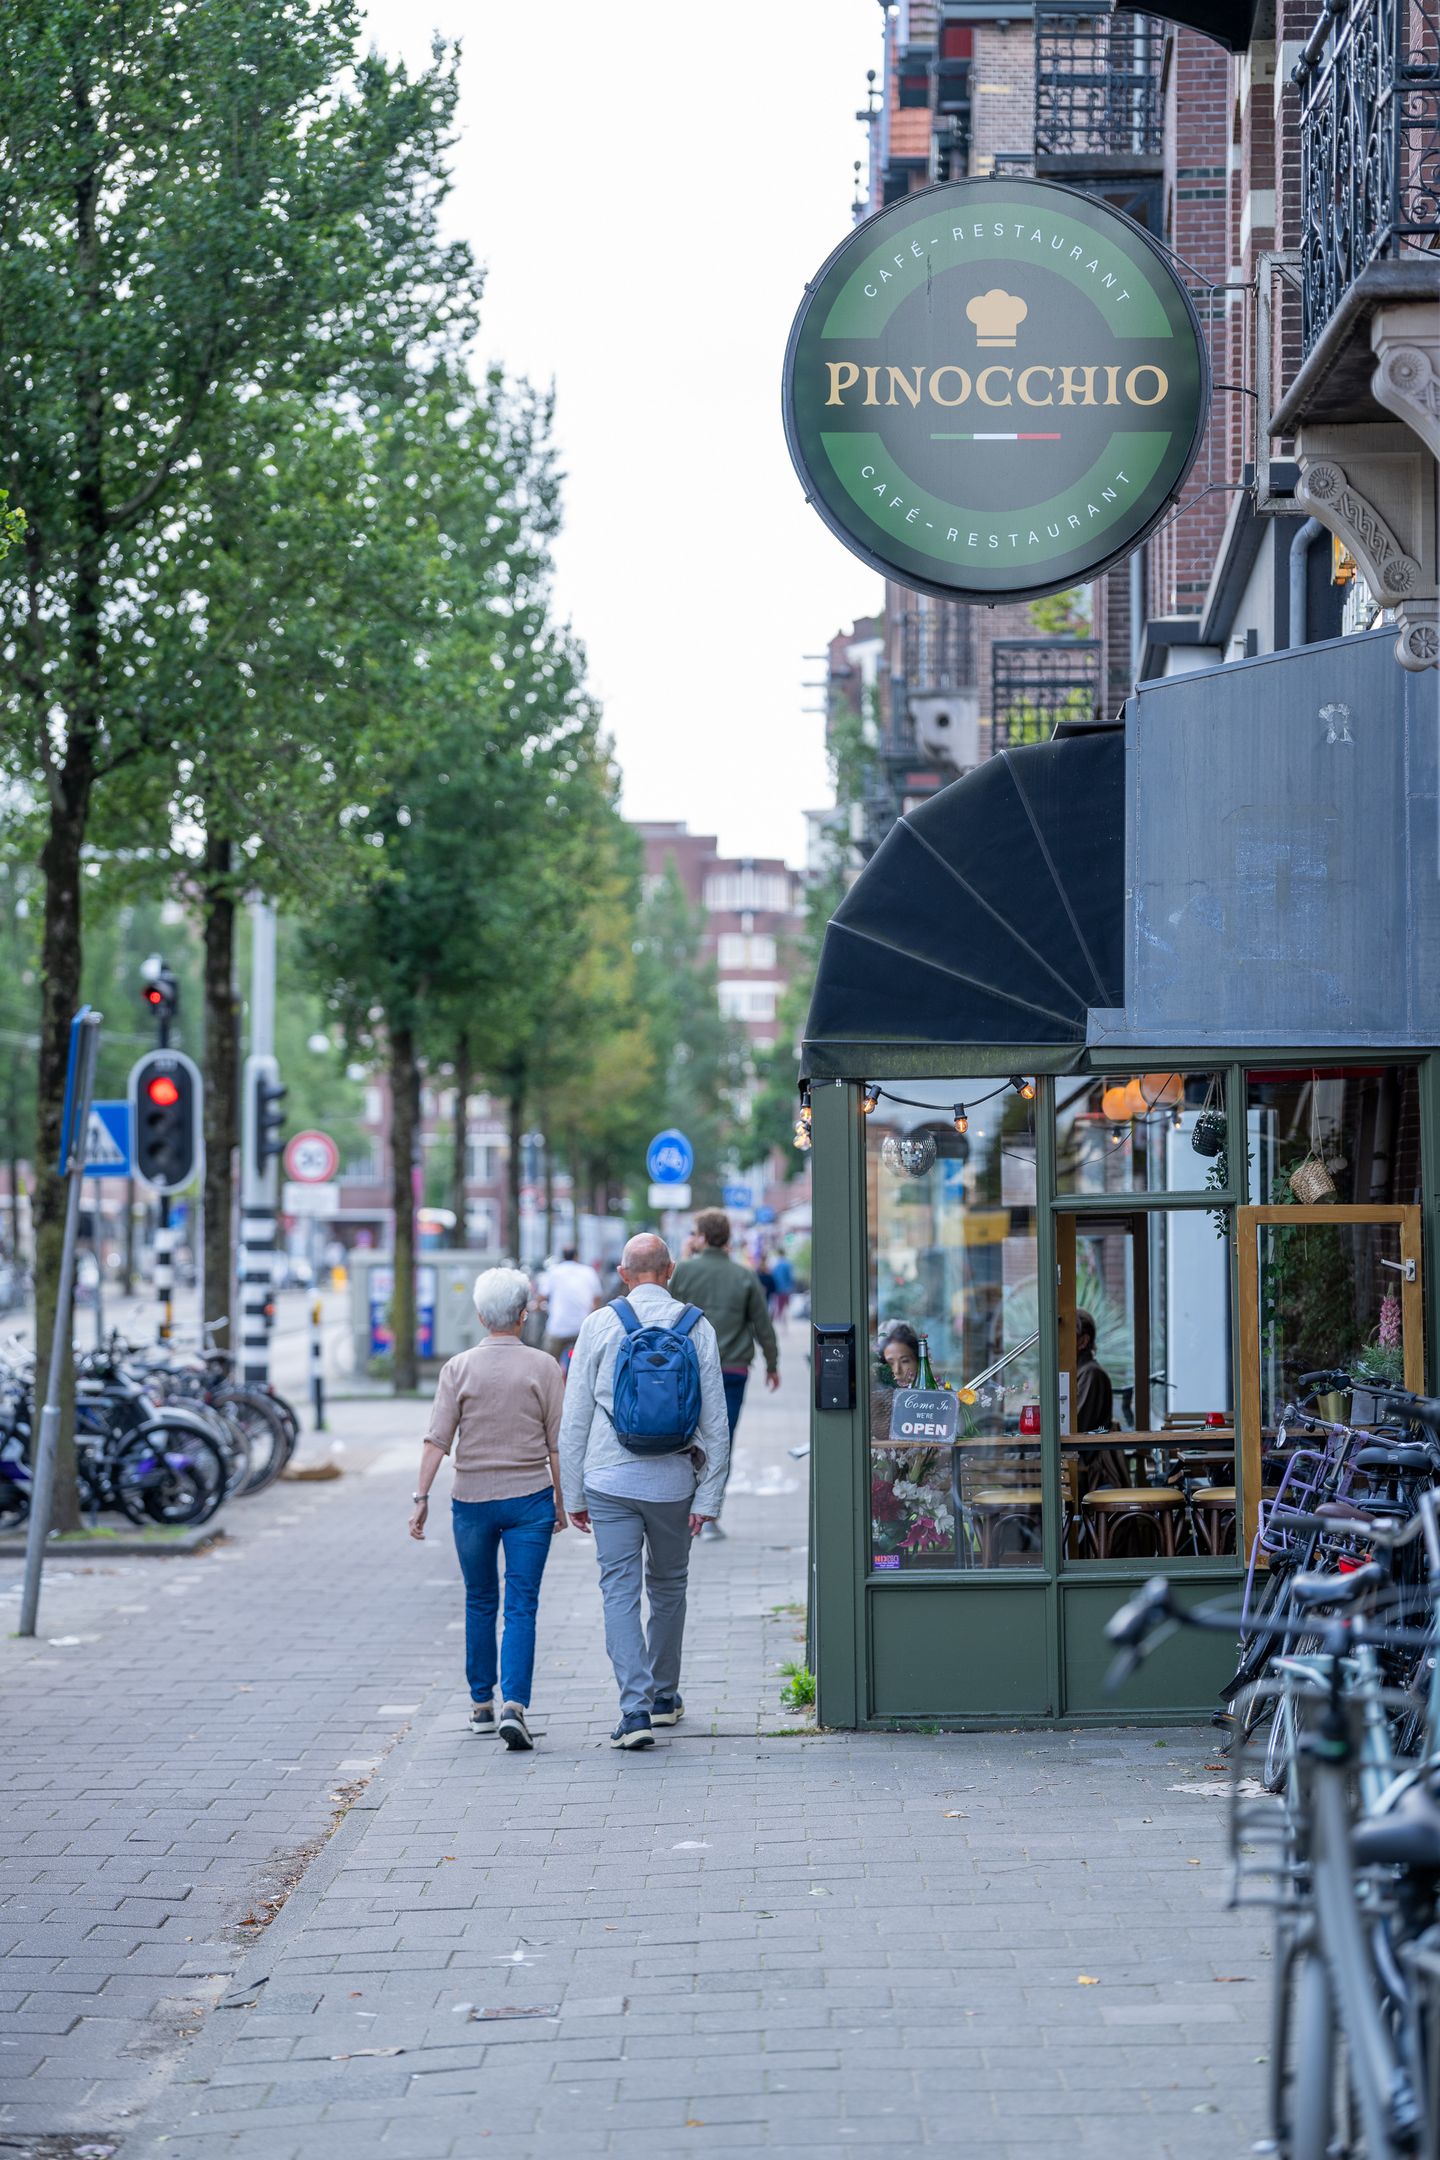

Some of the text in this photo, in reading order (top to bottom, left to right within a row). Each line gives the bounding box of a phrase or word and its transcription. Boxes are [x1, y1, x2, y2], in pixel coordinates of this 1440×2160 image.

[824, 361, 1169, 409] PINOCCHIO
[904, 1393, 935, 1410] Come
[901, 1422, 948, 1436] OPEN
